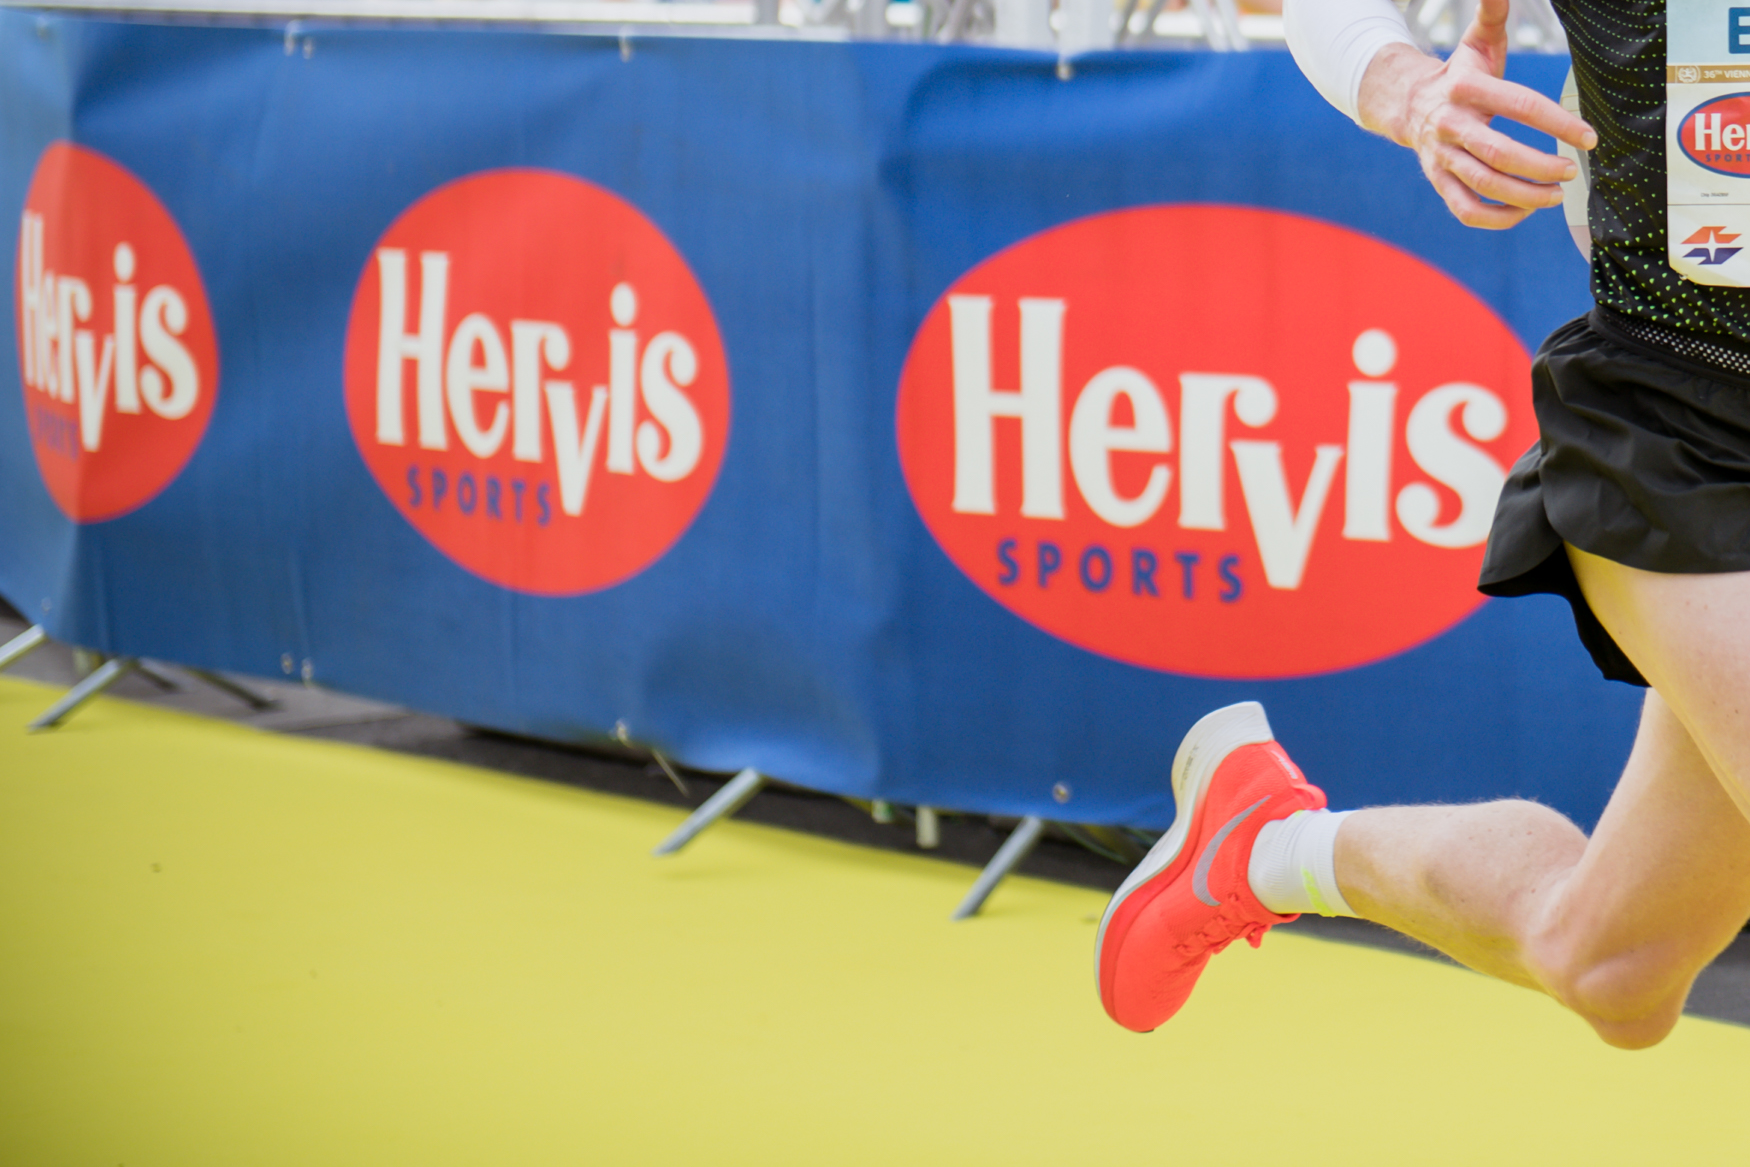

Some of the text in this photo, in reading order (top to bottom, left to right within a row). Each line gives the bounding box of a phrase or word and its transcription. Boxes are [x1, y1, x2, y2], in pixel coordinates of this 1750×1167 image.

[22, 208, 199, 453] Hervis
[376, 246, 704, 518] Hervis
[947, 293, 1511, 590] Hervis
[406, 465, 555, 529] SPORTS
[997, 538, 1244, 604] SPORTS
